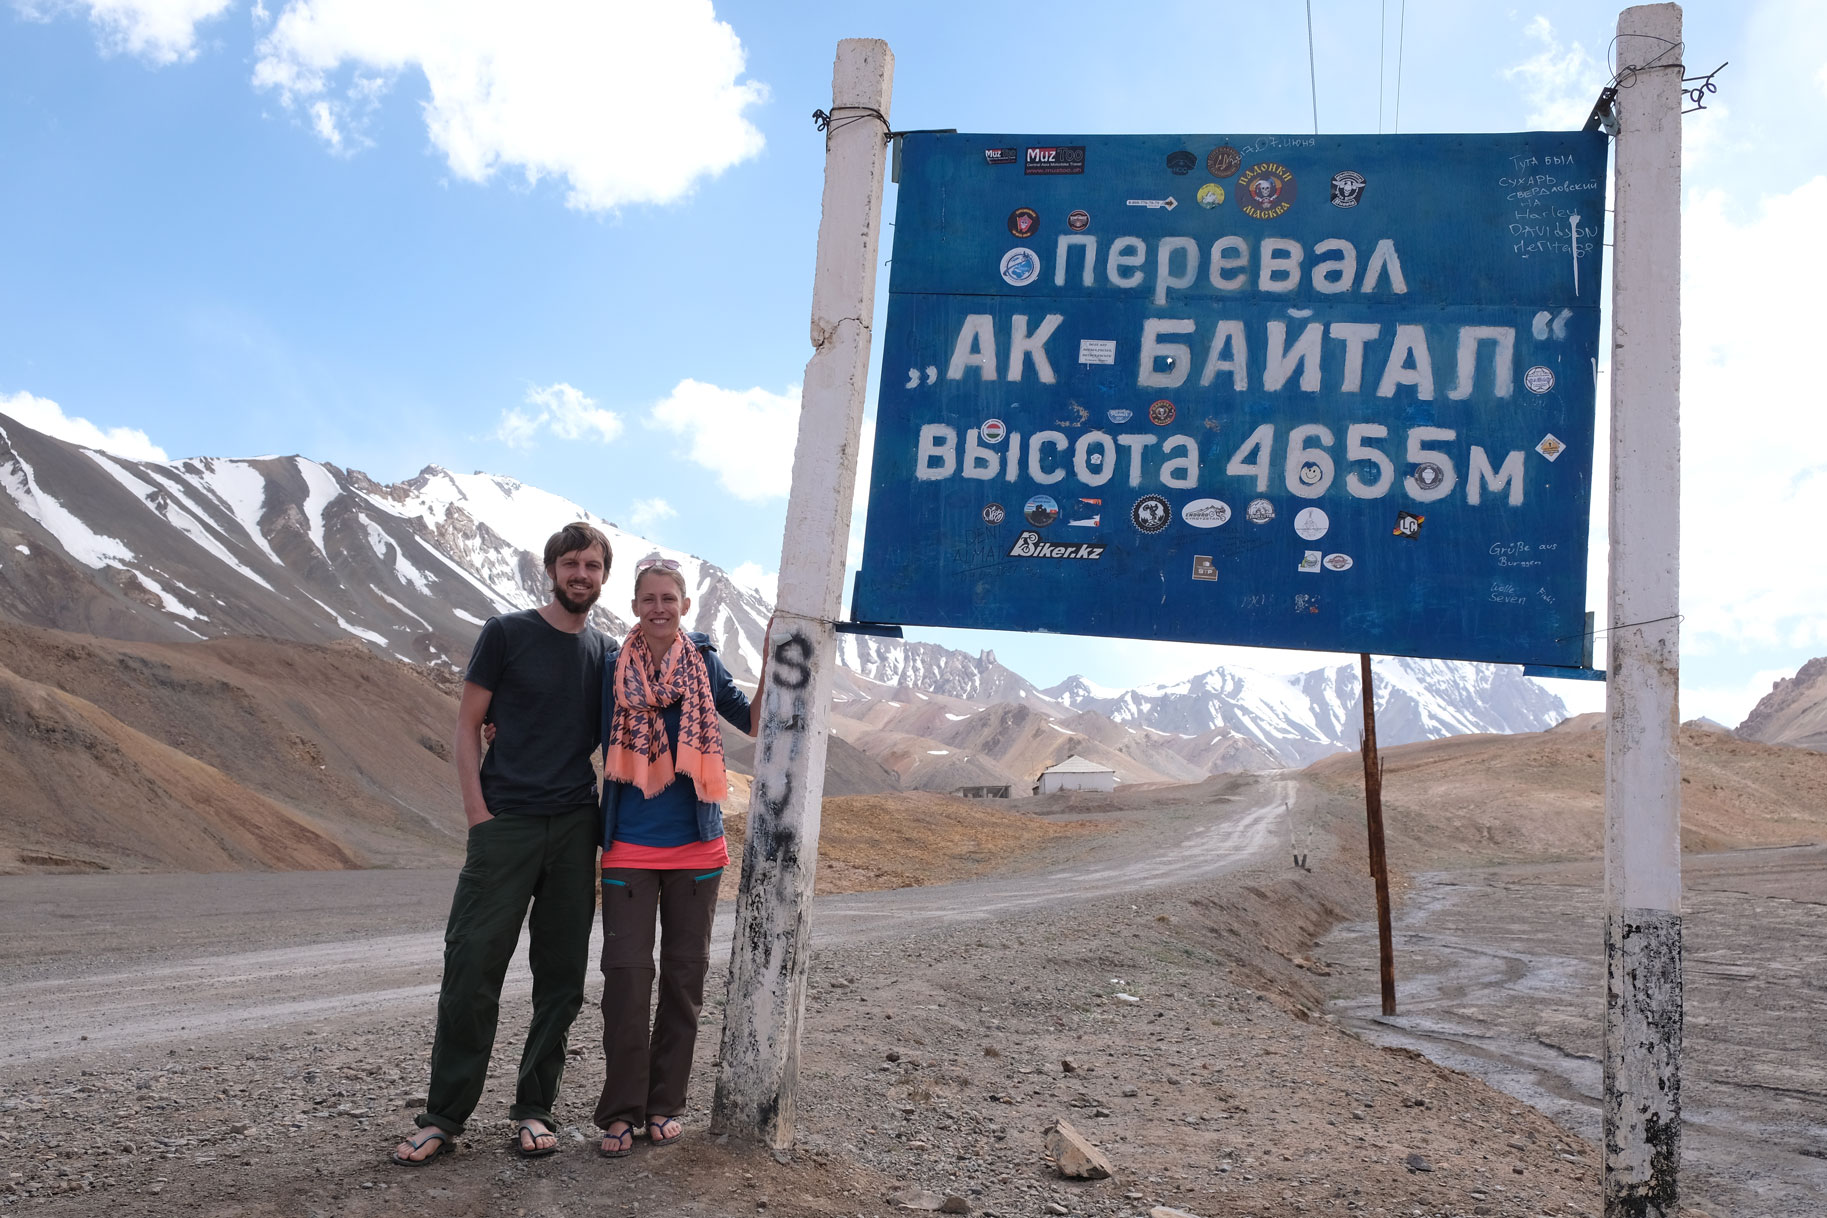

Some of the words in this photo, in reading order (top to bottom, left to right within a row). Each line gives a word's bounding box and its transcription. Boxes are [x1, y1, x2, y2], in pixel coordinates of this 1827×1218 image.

[1238, 162, 1293, 186] ПАДОНКИ
[1243, 201, 1291, 219] МАСКВА
[1515, 206, 1578, 220] Harley
[1009, 531, 1105, 560] Biker.kz
[1538, 542, 1558, 550] aus
